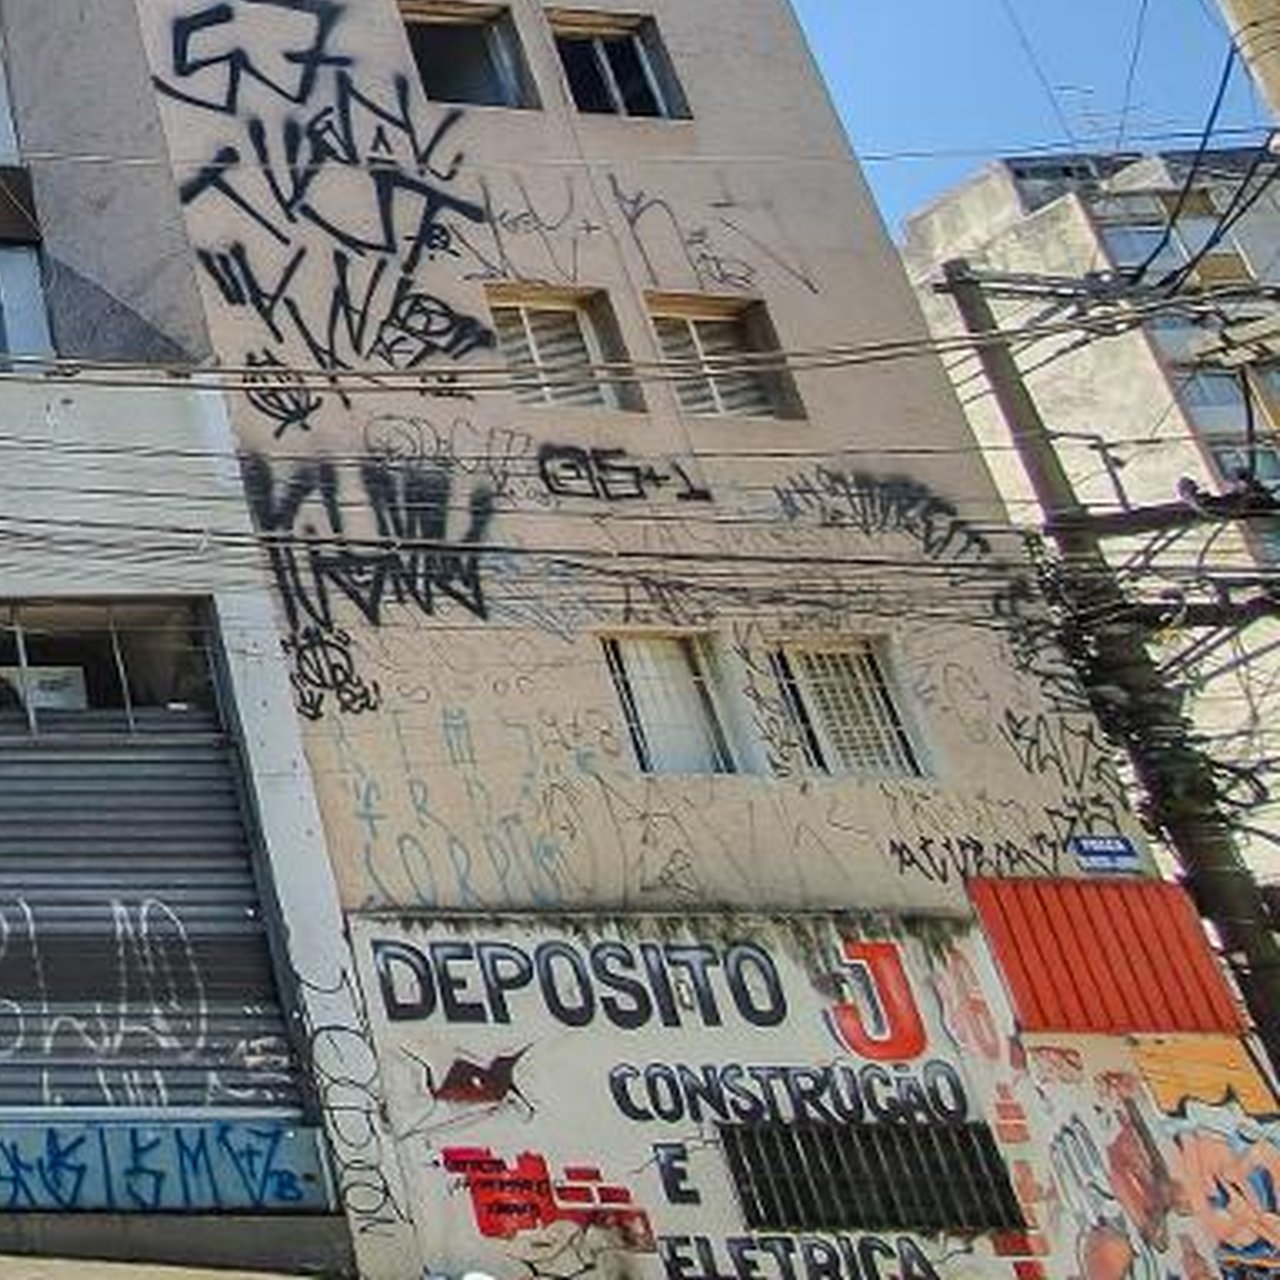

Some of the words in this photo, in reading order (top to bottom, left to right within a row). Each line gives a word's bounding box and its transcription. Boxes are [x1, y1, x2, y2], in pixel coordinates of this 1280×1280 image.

[370, 939, 788, 1030] DEPOSITO
[824, 942, 927, 1061] J
[651, 1143, 701, 1205] E
[658, 1236, 942, 1280] ELETRICA
